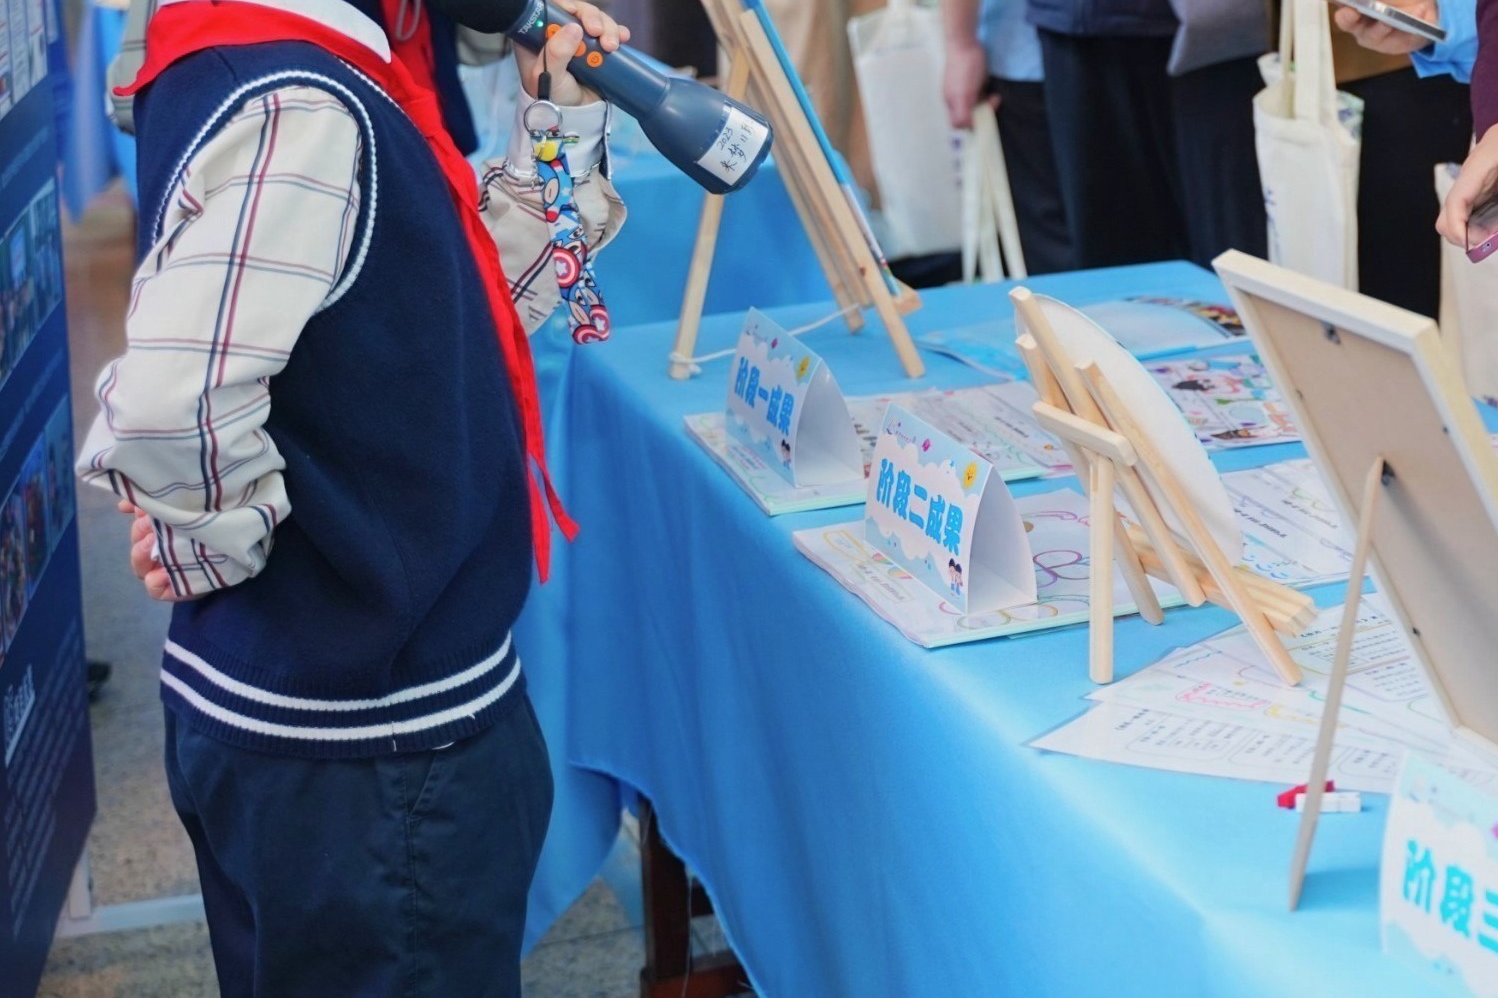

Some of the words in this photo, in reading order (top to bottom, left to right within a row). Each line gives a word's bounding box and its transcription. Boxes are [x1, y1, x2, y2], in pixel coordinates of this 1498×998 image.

[717, 127, 734, 151] 2023
[735, 356, 795, 436] 阶段一成果
[876, 458, 964, 556] 阶段二成果
